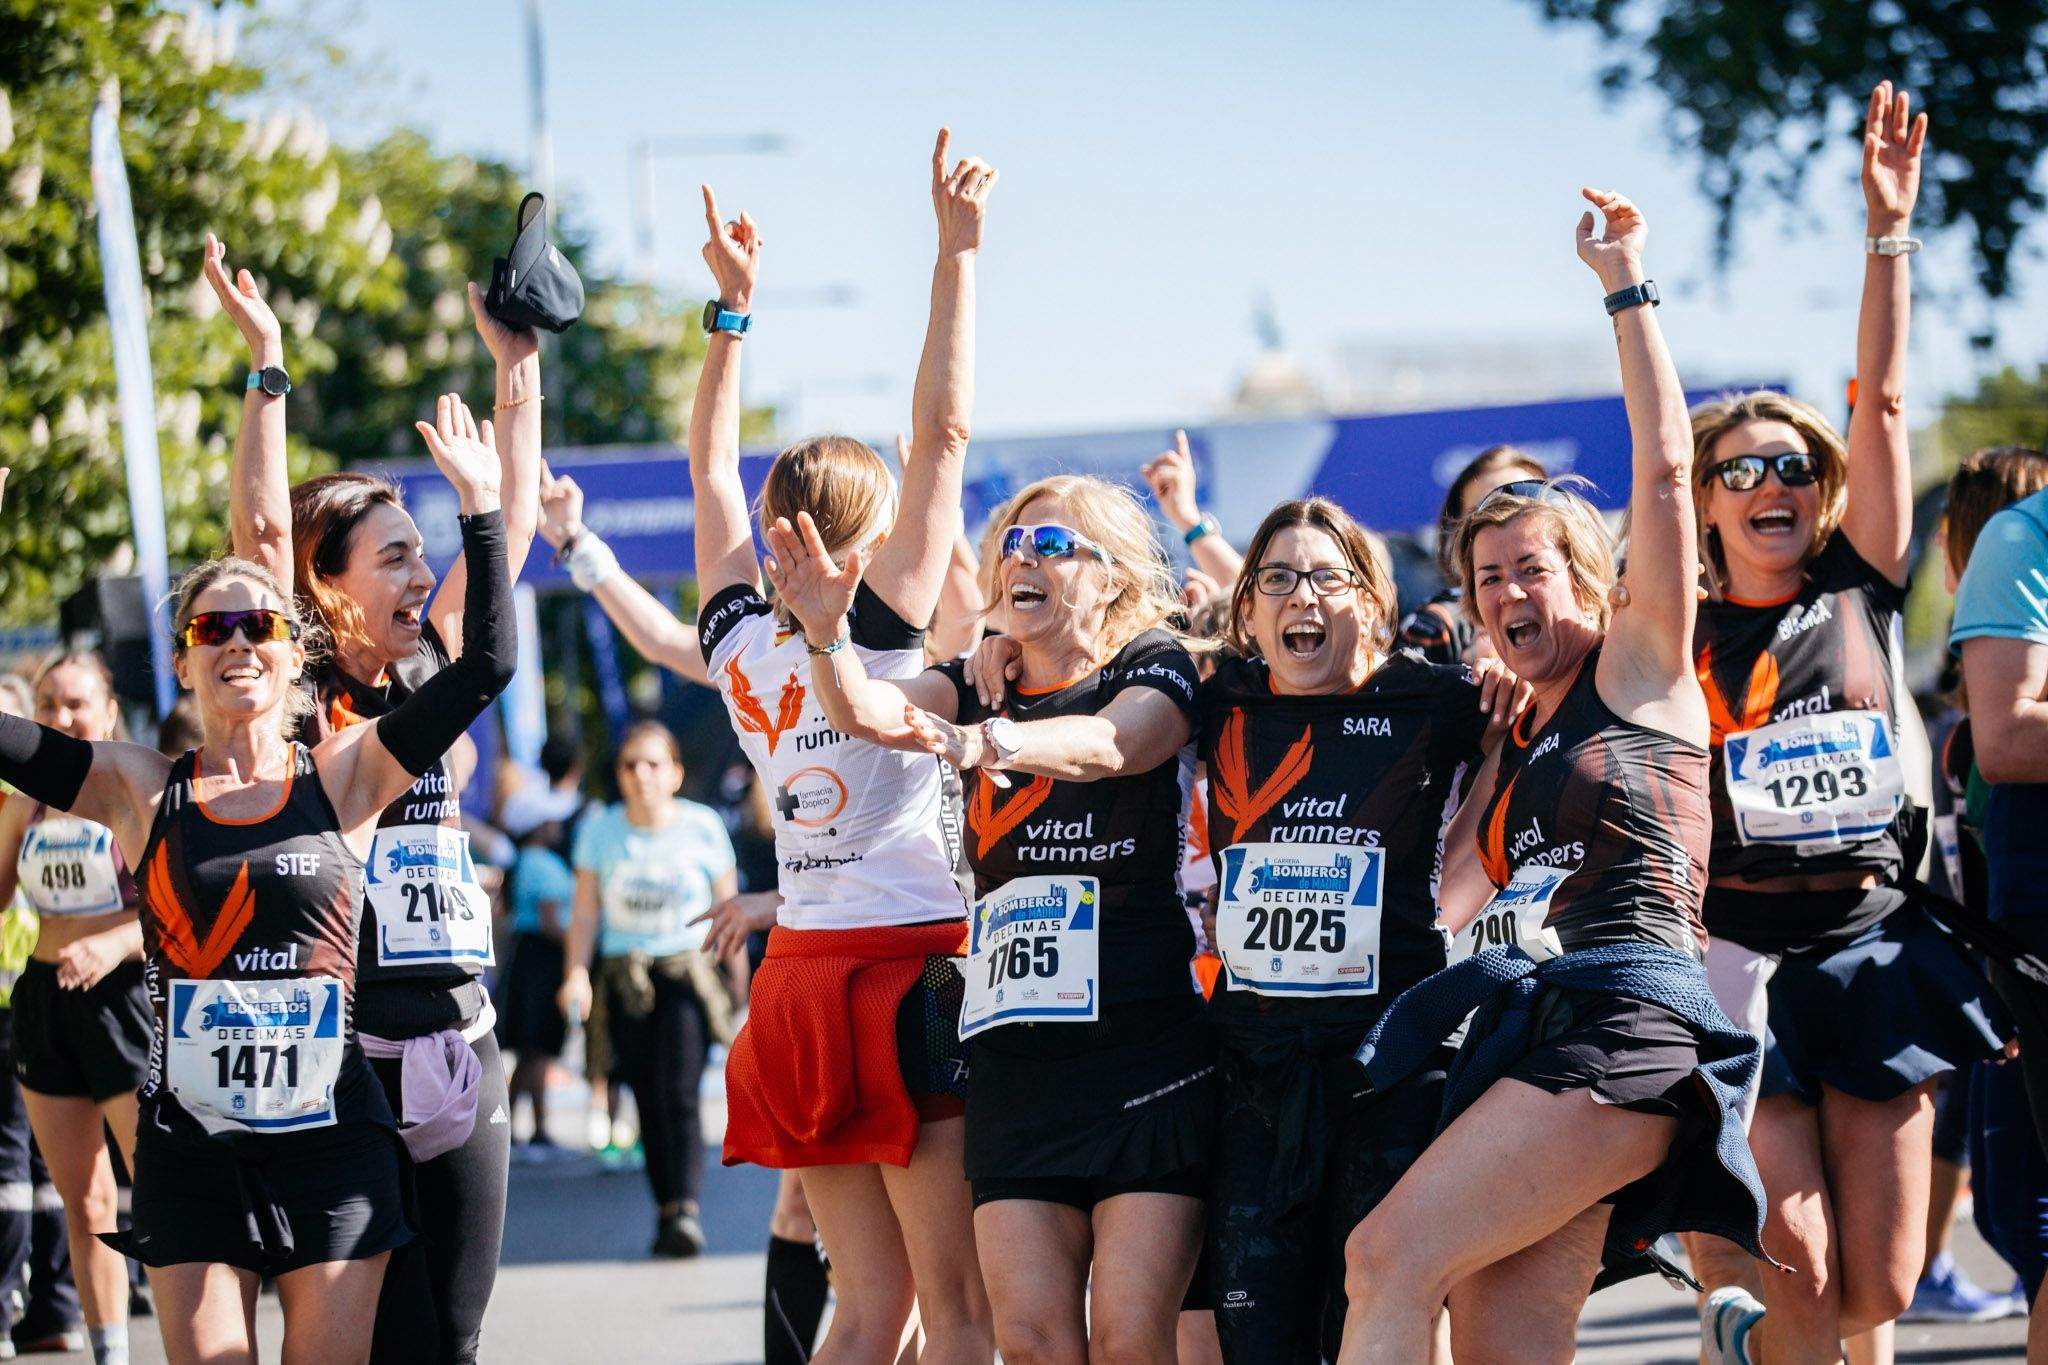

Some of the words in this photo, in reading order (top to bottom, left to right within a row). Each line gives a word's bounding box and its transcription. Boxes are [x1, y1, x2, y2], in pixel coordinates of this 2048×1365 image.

[1342, 717, 1392, 737] SARA
[1775, 752, 1861, 774] DECIMAS
[411, 768, 453, 796] vital
[1764, 767, 1867, 808] 1293
[1282, 793, 1347, 819] vital
[1025, 812, 1094, 840] vital
[1270, 824, 1382, 848] runners
[1509, 816, 1546, 860] vital
[1017, 838, 1136, 862] runners
[1273, 857, 1300, 865] CARRERA
[41, 862, 87, 890] 498
[275, 853, 321, 876] STEF
[1272, 865, 1348, 879] BOMBEROS
[401, 882, 474, 924] 2149
[997, 896, 1064, 917] BOMBEROS
[1263, 891, 1344, 905] DECIMAS
[994, 920, 1061, 944] DECIMAS
[1243, 906, 1347, 953] 2025
[1471, 910, 1518, 956] 290
[235, 942, 298, 972] vital
[987, 936, 1059, 990] 1765
[218, 1027, 306, 1040] DECIMAS
[211, 1044, 299, 1089] 1471
